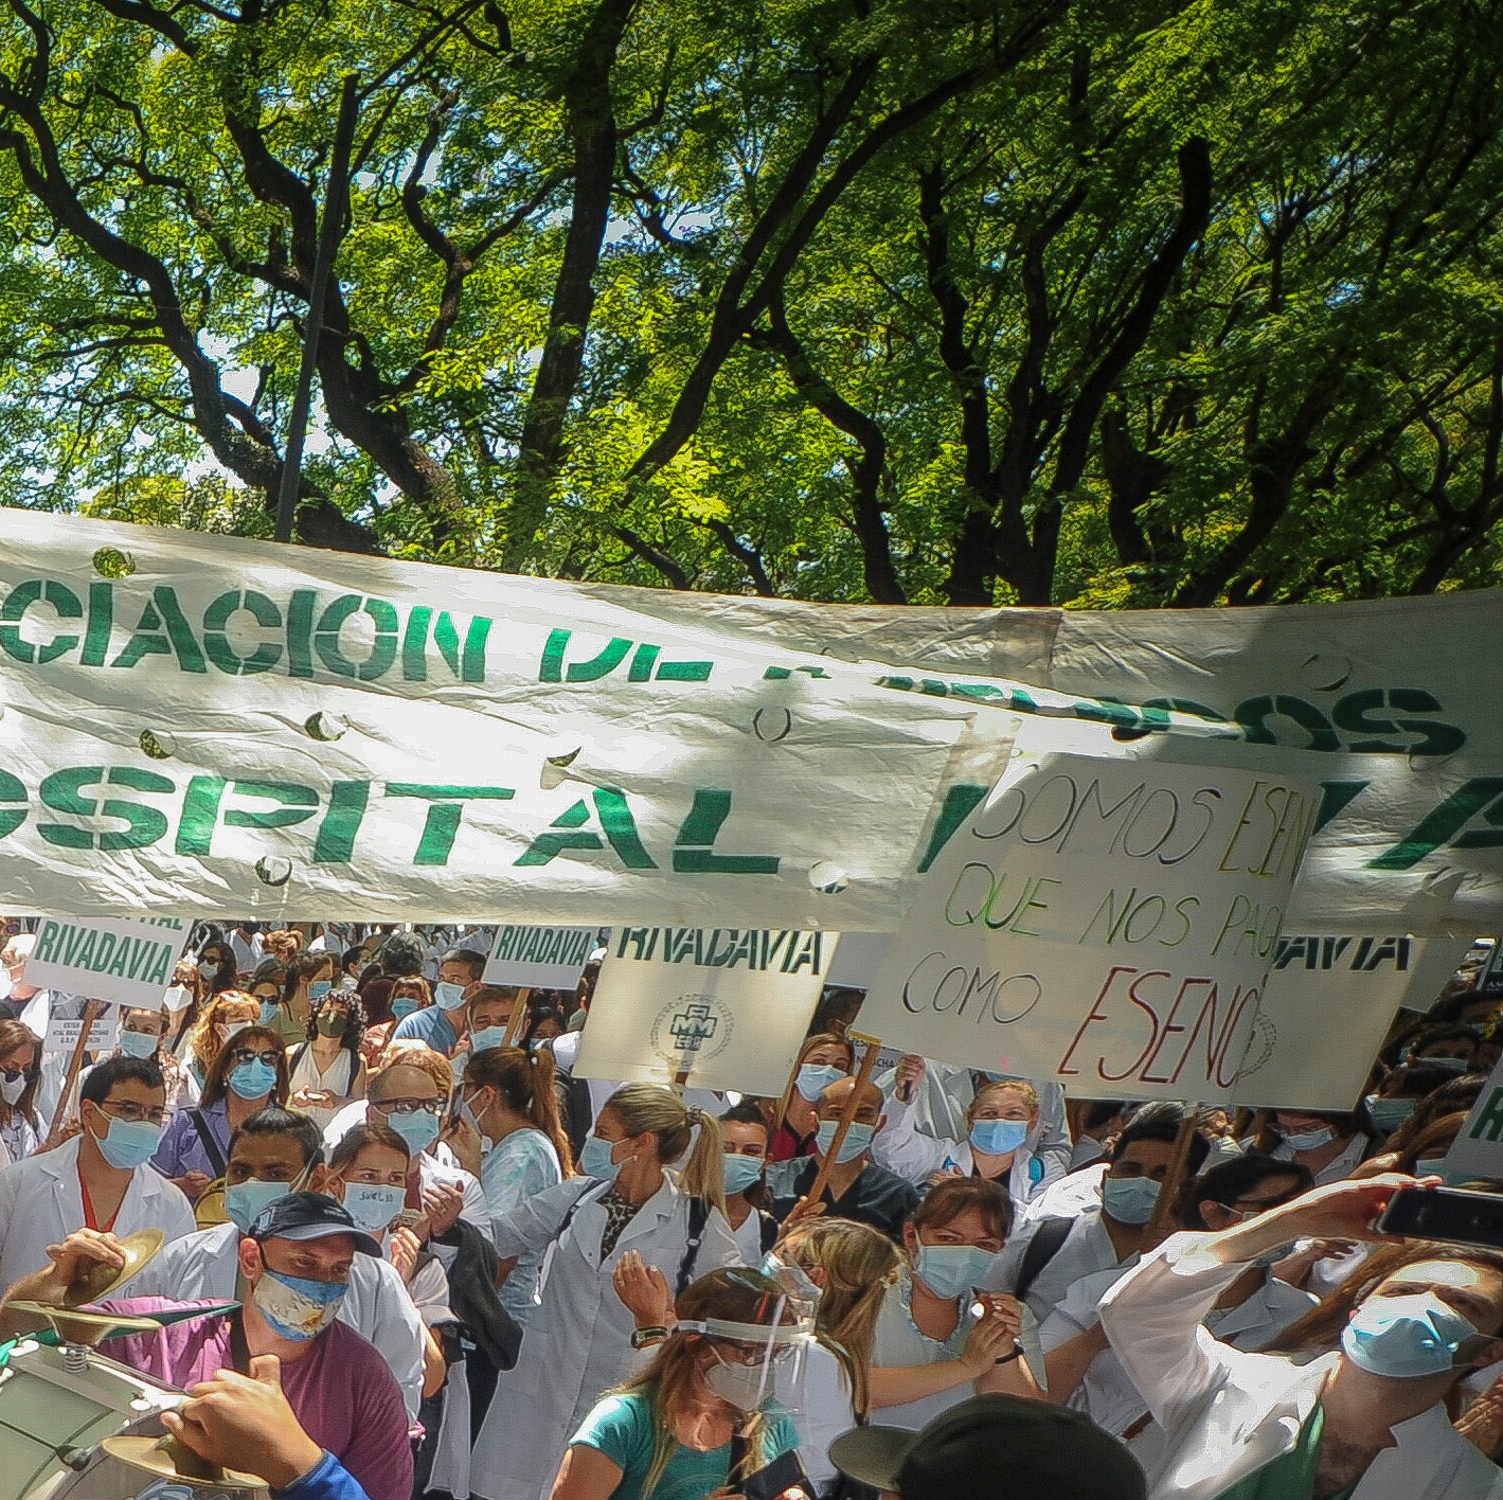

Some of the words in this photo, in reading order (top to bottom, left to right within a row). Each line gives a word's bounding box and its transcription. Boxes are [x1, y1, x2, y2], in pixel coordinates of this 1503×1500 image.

[944, 861, 1063, 938] QUE
[1078, 887, 1202, 948] NOS
[34, 920, 174, 985] RIVADAVIA
[495, 925, 592, 966] RIVADAVIA
[901, 951, 1044, 1024] COMO
